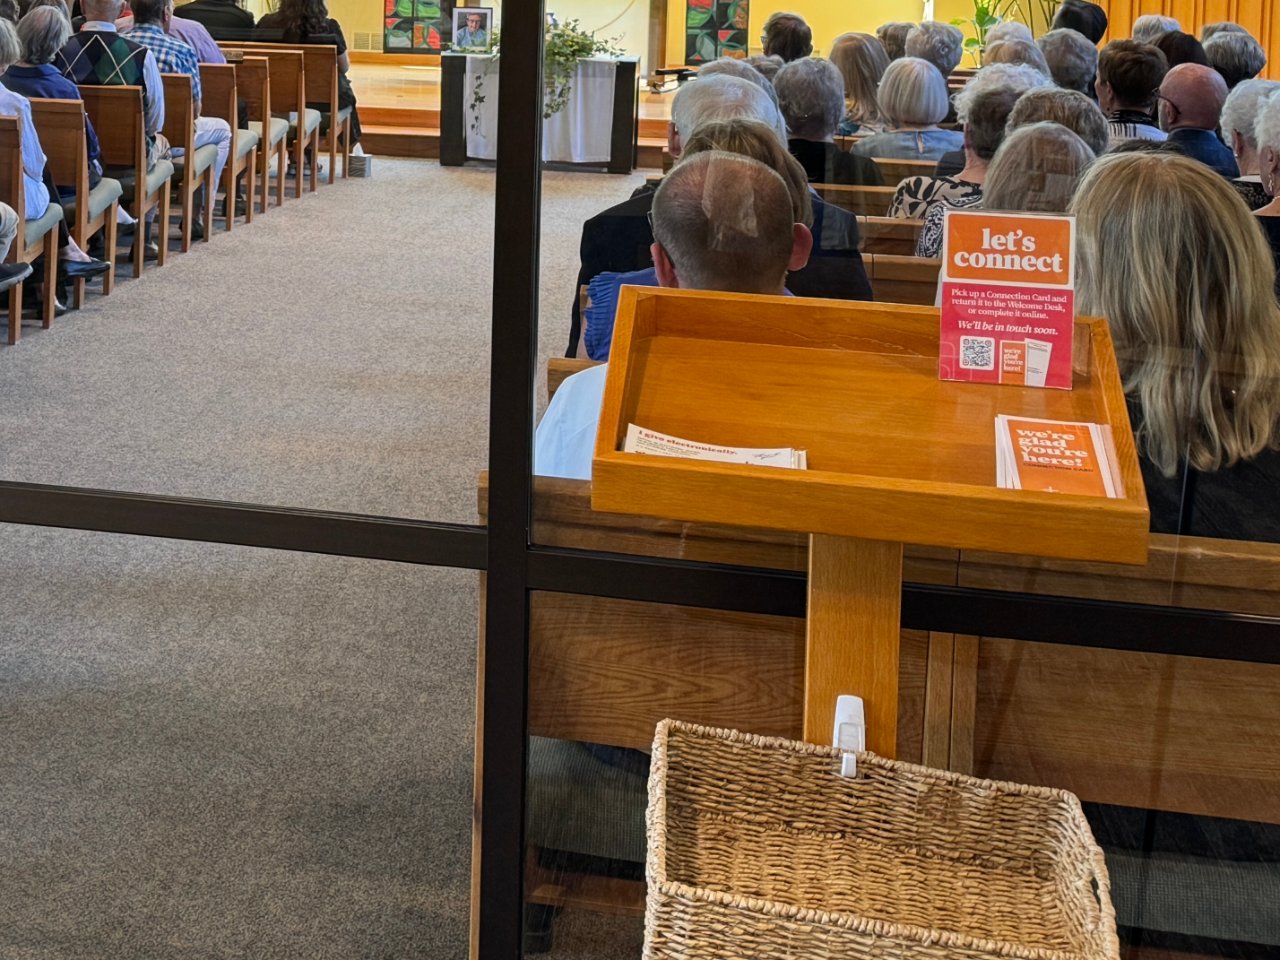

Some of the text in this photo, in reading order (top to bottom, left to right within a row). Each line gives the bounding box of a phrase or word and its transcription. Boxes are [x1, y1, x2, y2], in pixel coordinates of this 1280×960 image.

[981, 227, 1036, 252] let's
[953, 251, 1063, 273] connect
[951, 288, 968, 297] Pick
[969, 290, 980, 298] up
[986, 290, 1031, 301] Connection
[1032, 294, 1051, 302] Card
[1051, 295, 1067, 303] and
[951, 298, 976, 306] return
[978, 298, 984, 306] it
[994, 300, 1006, 308] the
[1007, 300, 1043, 310] Welcome
[1044, 303, 1066, 313] Desk,
[978, 308, 1014, 318] complete
[1022, 310, 1049, 319] online.
[958, 321, 1059, 335] We'll be in touch soon.
[1016, 429, 1076, 441] we're
[1018, 436, 1068, 448] glad
[644, 433, 665, 442] give
[666, 438, 739, 455] electronically.
[1020, 445, 1089, 457] you're
[1021, 451, 1083, 467] here!
